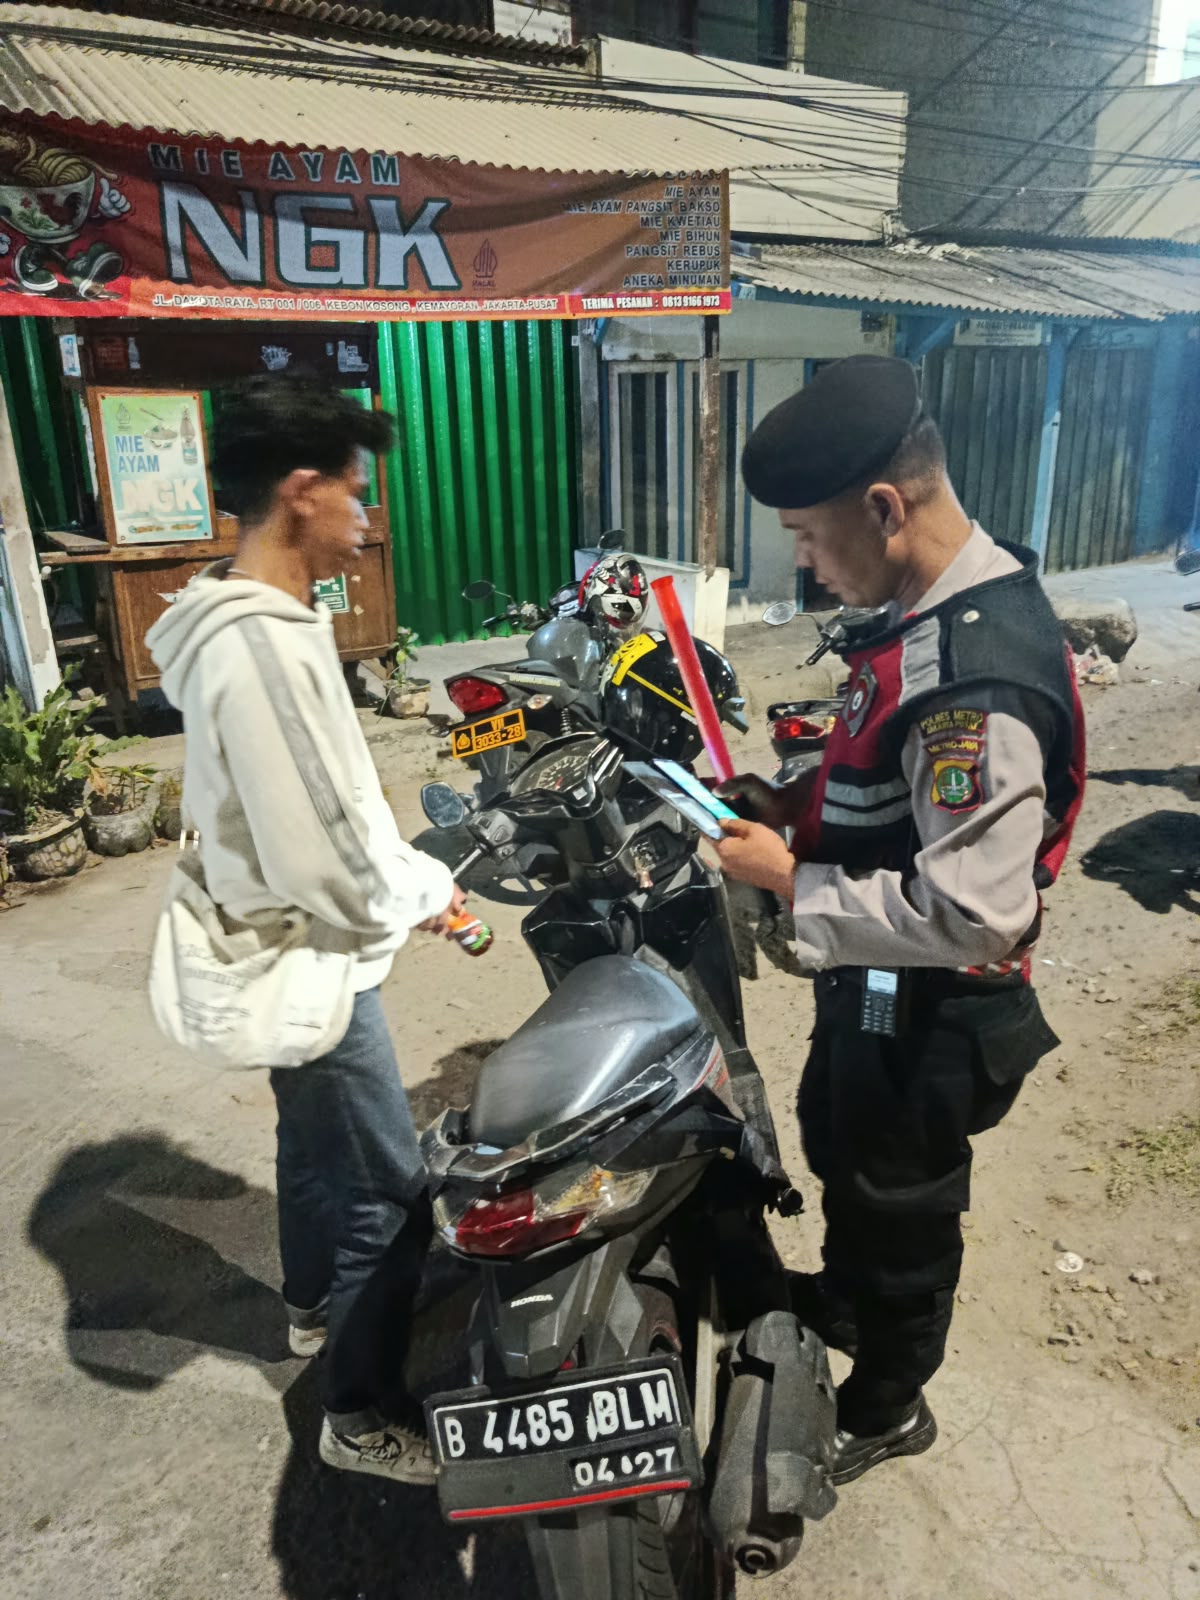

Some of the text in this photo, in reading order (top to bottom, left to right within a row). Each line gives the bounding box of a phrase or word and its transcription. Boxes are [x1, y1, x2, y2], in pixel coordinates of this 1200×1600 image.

[148, 143, 400, 186] MIE AYAM
[664, 186, 721, 198] MIE AYAM
[590, 201, 622, 213] AYAM
[625, 201, 678, 213] PANGSIT
[679, 201, 720, 213] BAKSO
[640, 216, 720, 228] MIE KWETIAU
[160, 180, 462, 290] NGK
[659, 230, 720, 242] MIE BIHUN
[625, 245, 721, 258] PANGSIT REBUS
[667, 260, 721, 272] KERUPUK
[623, 273, 721, 287] ANEKA MINUMAN
[260, 298, 276, 309] RT
[277, 299, 295, 310] 001
[326, 300, 363, 311] KEBON
[365, 301, 410, 312] KOSONG
[582, 297, 614, 310] TERIMA
[616, 296, 653, 309] PESANAN
[115, 435, 144, 453] MIE
[118, 455, 160, 473] AYAM
[121, 479, 203, 513] NGK
[511, 1294, 554, 1308] HONDA
[444, 1379, 673, 1458] B 4485 BLM
